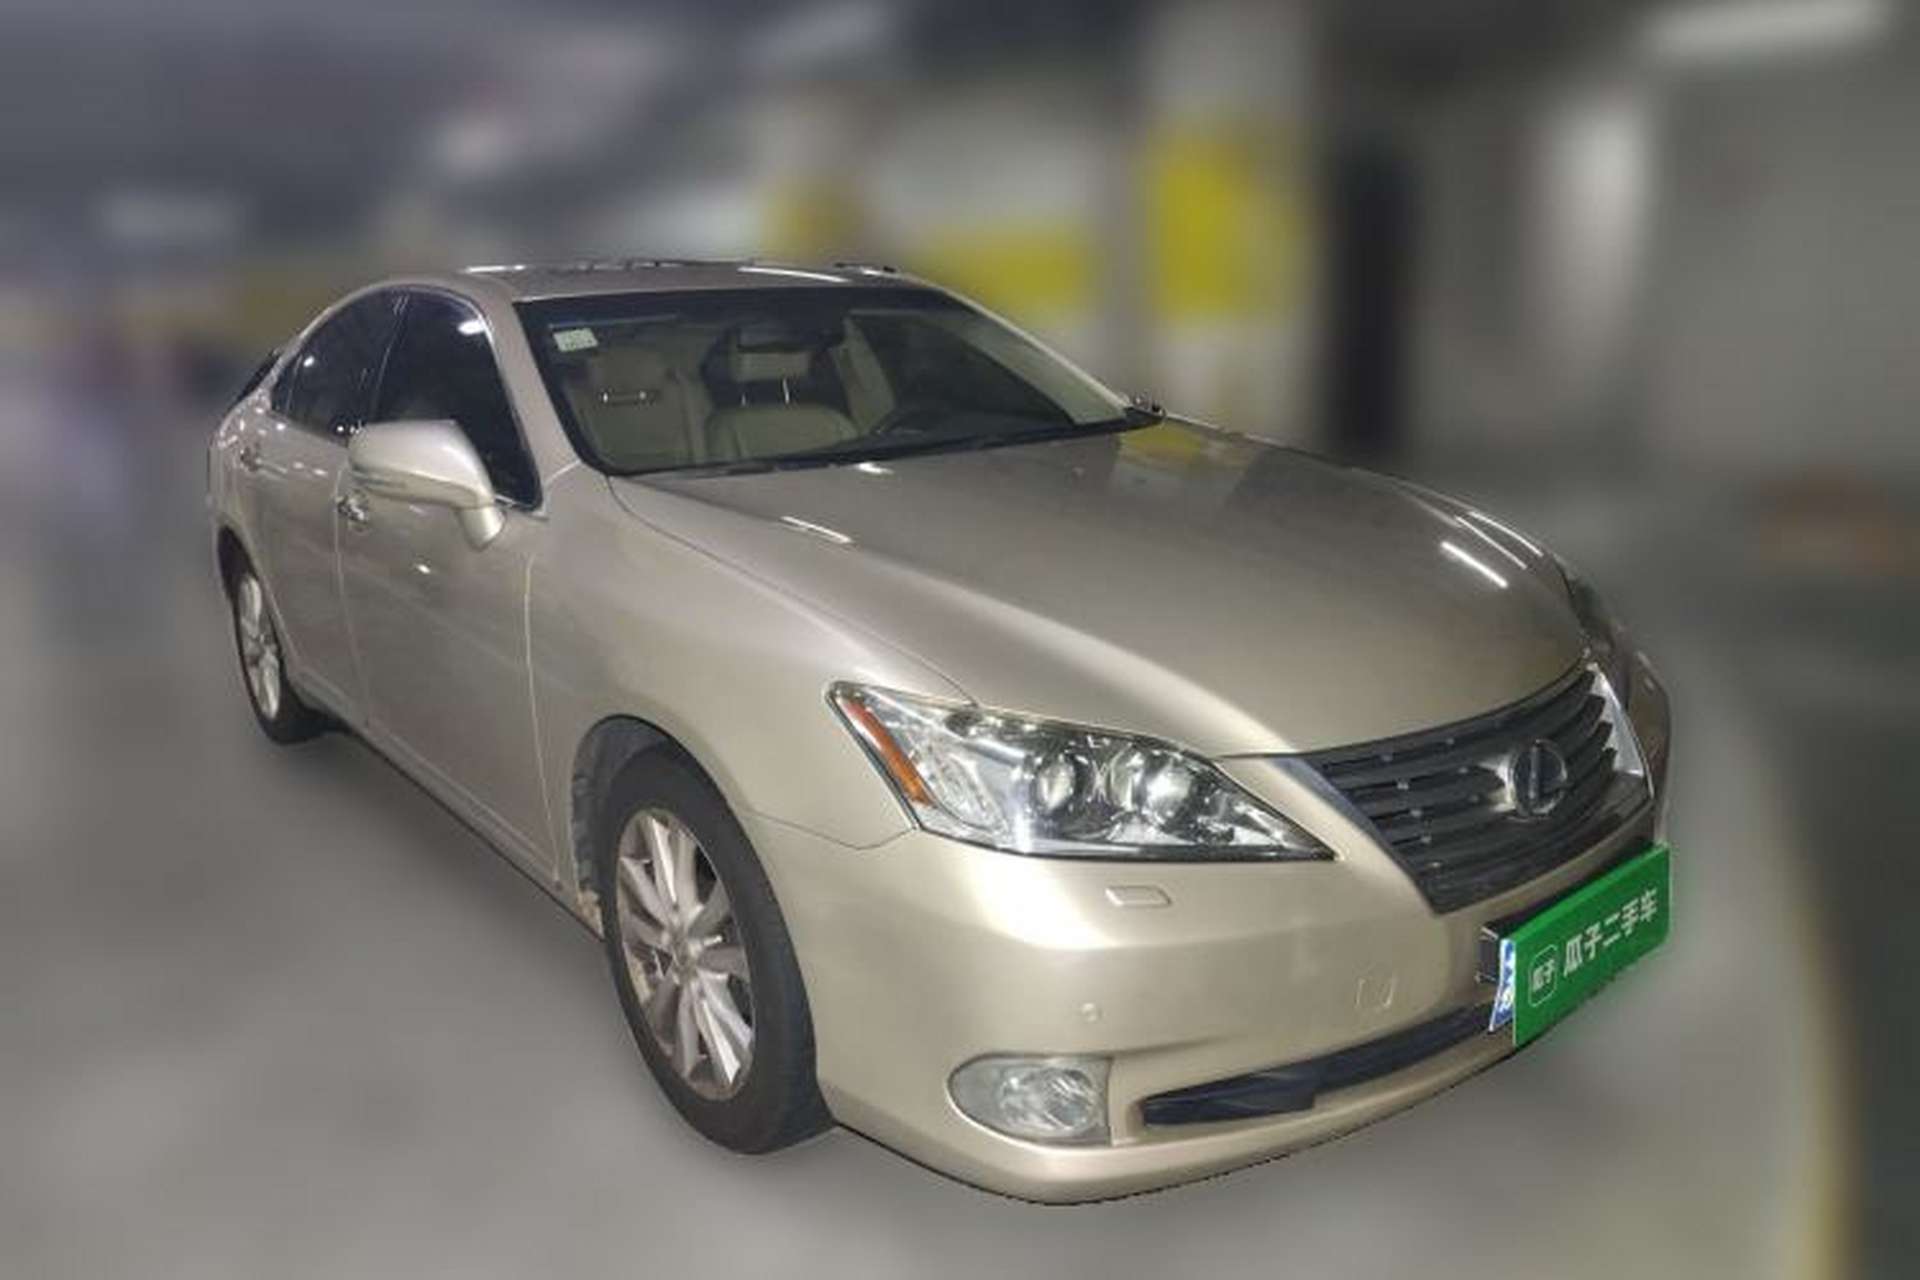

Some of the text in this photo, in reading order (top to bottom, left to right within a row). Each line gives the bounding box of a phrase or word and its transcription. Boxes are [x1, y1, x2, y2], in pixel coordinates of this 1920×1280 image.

[1563, 888, 1658, 977] 瓜子二手车
